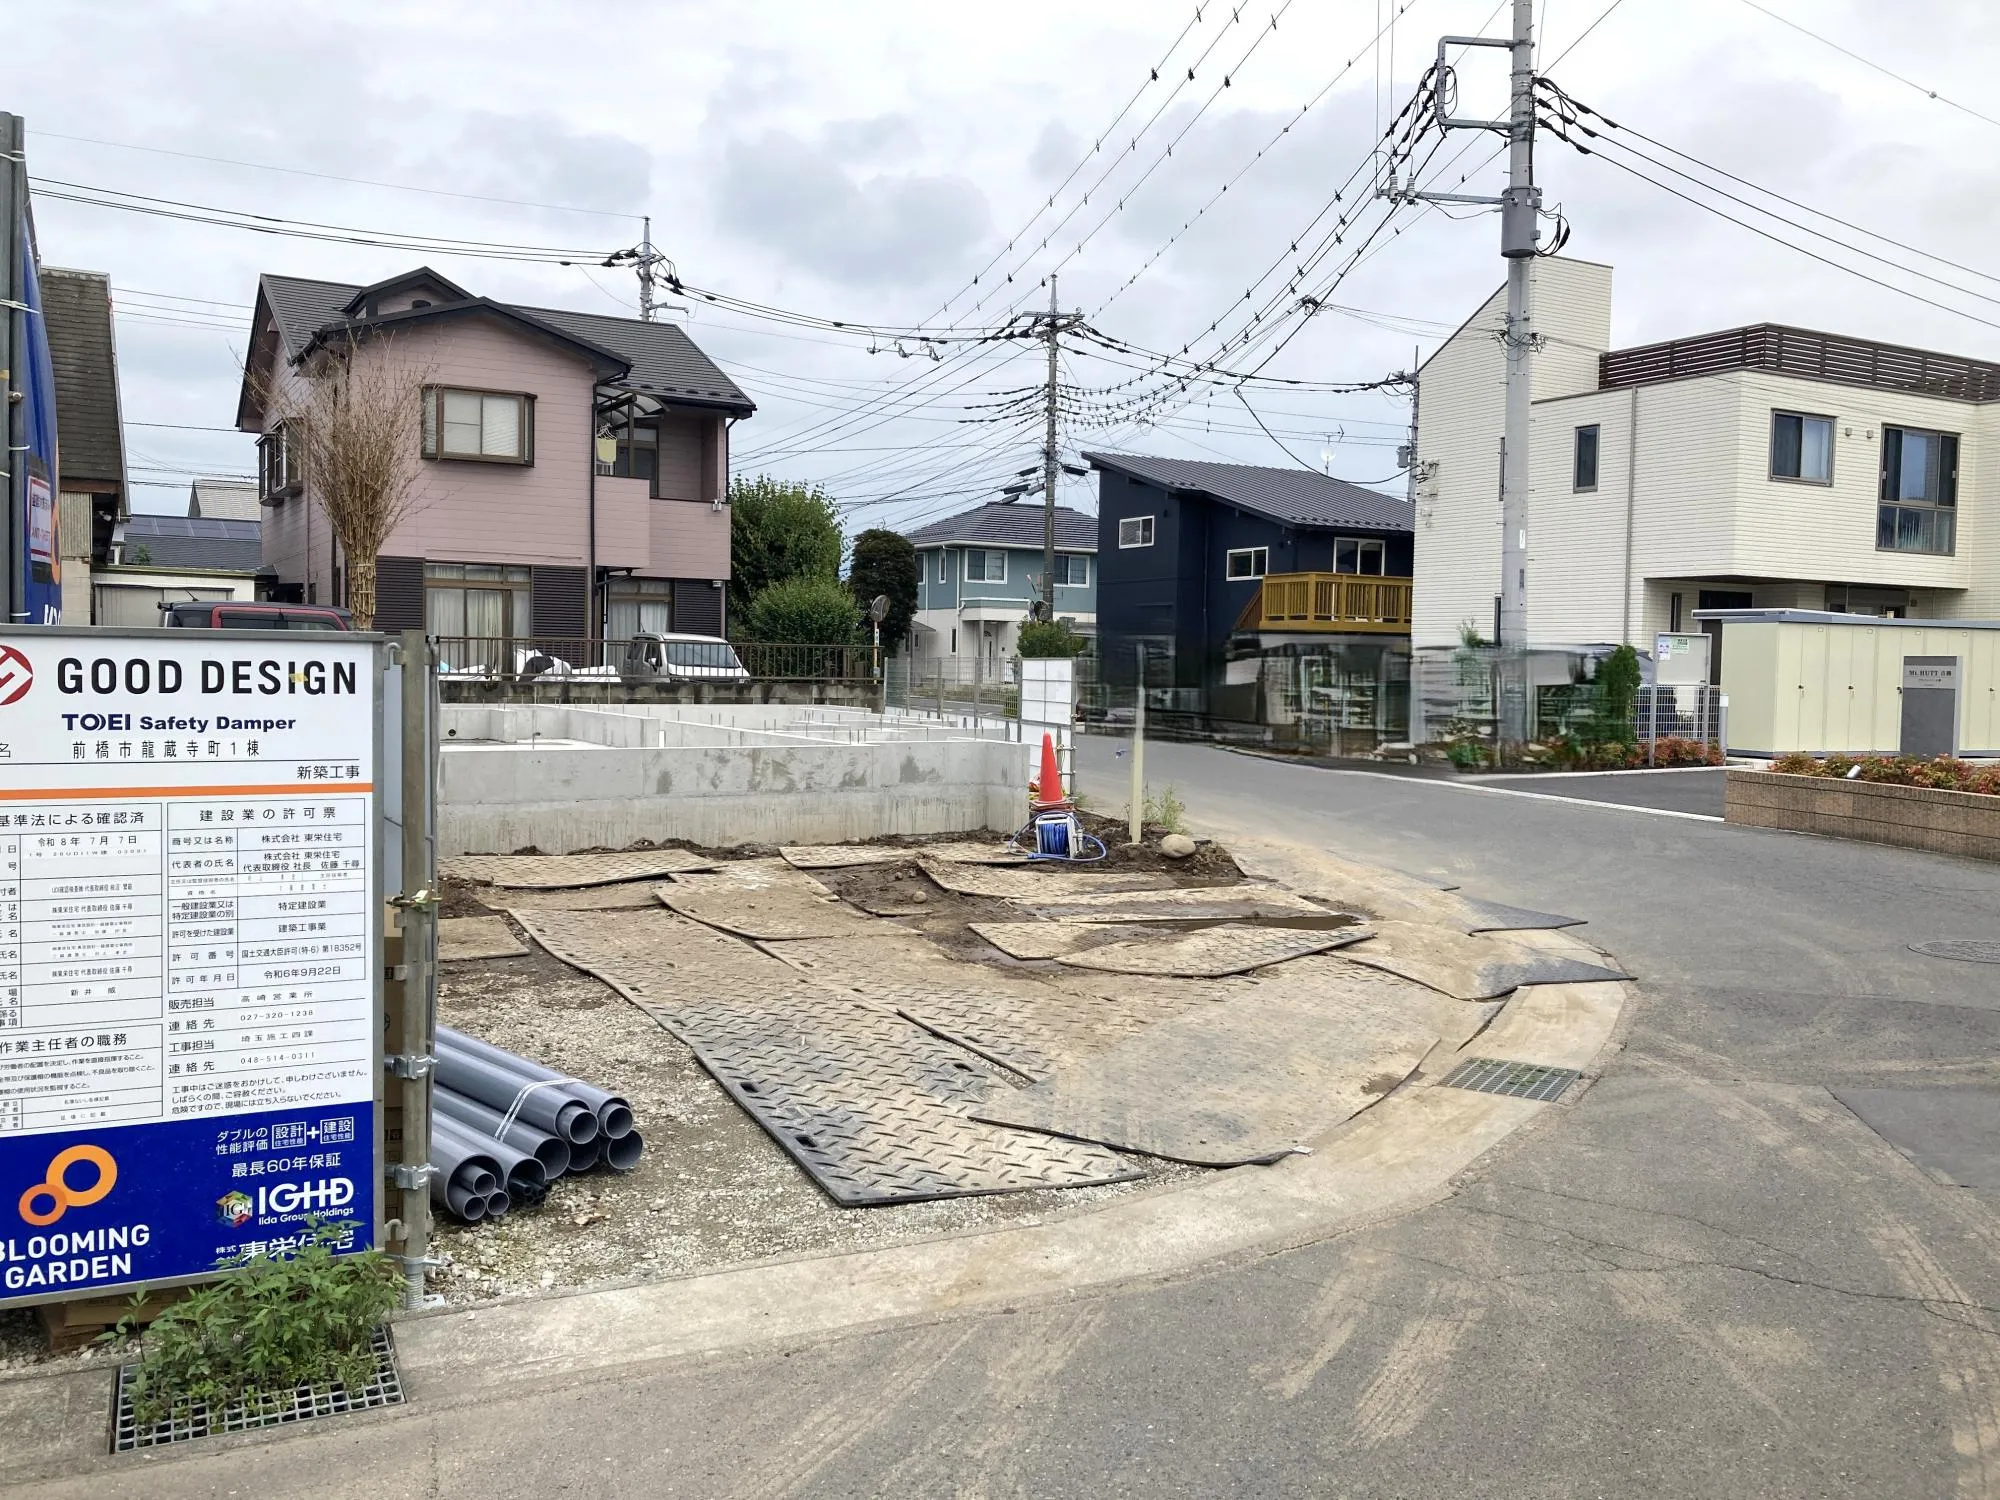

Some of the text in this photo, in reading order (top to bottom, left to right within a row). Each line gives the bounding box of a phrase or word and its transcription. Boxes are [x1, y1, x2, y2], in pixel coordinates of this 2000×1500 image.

[57, 657, 356, 695] GOOD DESIGN
[62, 713, 296, 734] TOEI Safety Damper
[297, 765, 360, 780] 新築工事
[200, 806, 336, 822] 建設業の許可票
[262, 832, 342, 843] 株式会社 東栄住宅
[264, 850, 340, 861] 株式会社 東栄住宅
[172, 859, 234, 869] 代表者の氏名
[172, 900, 234, 911] 一般建設業又は
[278, 900, 326, 910] 特定建設業
[172, 910, 234, 920] 特定建設業の別
[172, 927, 234, 938] 許可を受けた建設業
[278, 922, 326, 933] 建築工事業
[172, 950, 234, 962] 許可番号
[172, 972, 235, 985] 許可年月日
[264, 965, 341, 979] 令和6年9月22日
[168, 997, 215, 1010] 販売担当
[168, 1018, 215, 1031] 連絡先
[0, 1032, 127, 1054] 作業主任者の職務
[168, 1039, 215, 1053] 工事担当
[168, 1060, 215, 1074] 連絡先
[217, 1127, 268, 1142] ダブルの
[275, 1125, 304, 1139] 設計
[324, 1119, 352, 1134] 建設
[216, 1139, 268, 1155] 性能評価
[232, 1152, 342, 1178] 最長60年保証
[259, 1177, 354, 1215] IGHD
[5, 1253, 131, 1289] GARDEN
